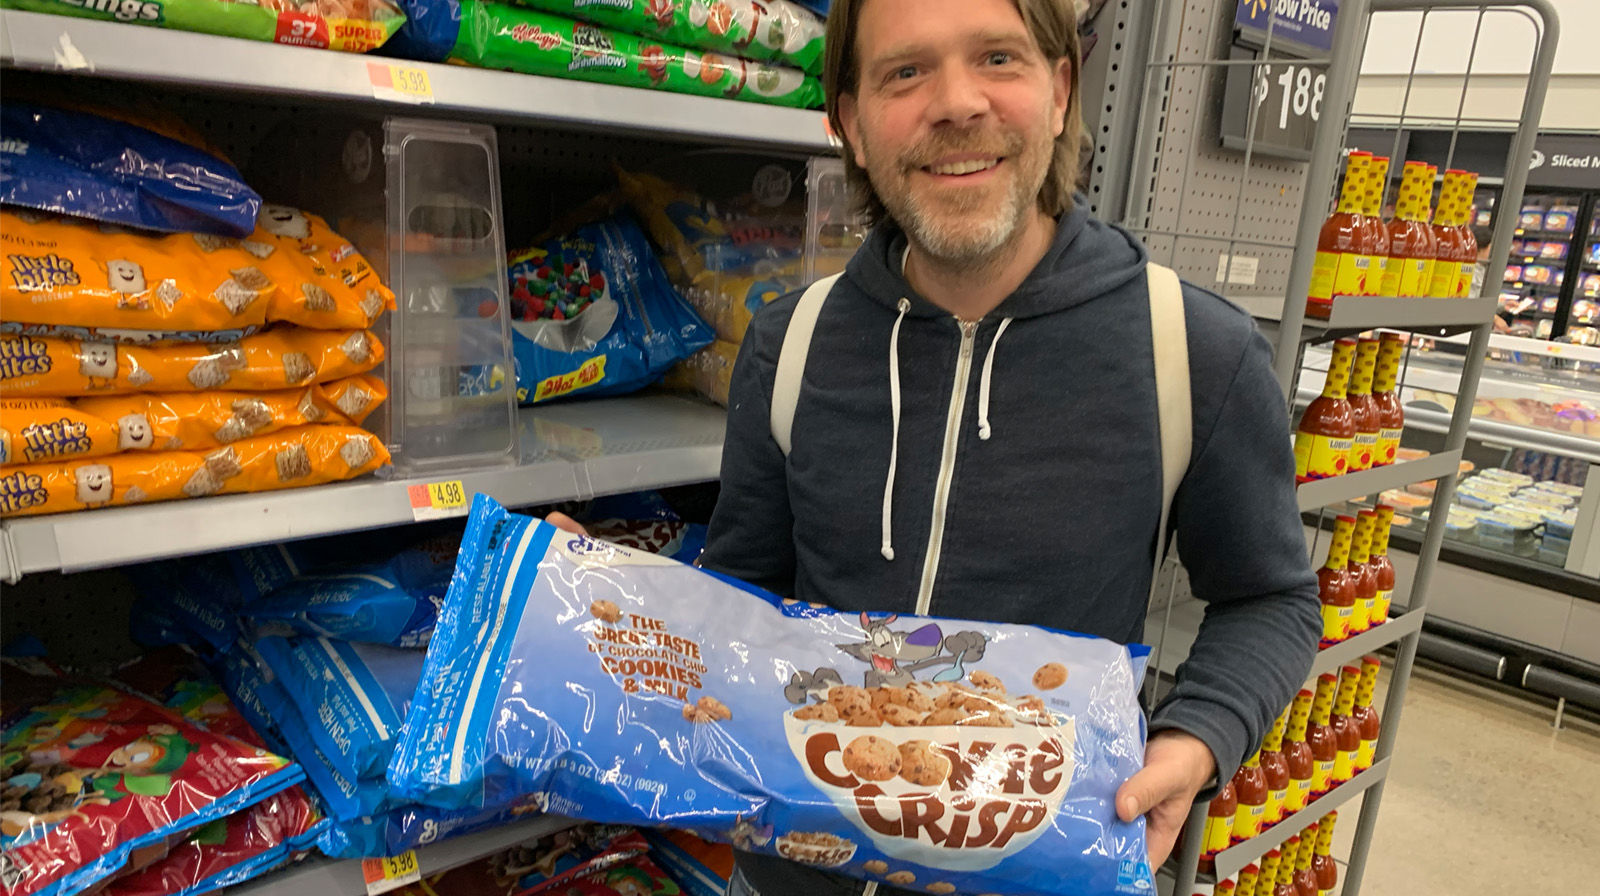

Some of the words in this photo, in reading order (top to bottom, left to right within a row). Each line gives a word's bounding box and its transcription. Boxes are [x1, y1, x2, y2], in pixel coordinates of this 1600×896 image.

[1270, 0, 1298, 19] ow
[1298, 0, 1331, 31] Price
[290, 19, 317, 38] 37
[335, 25, 382, 41] SUPER
[512, 22, 562, 52] Kellogg's
[1550, 153, 1590, 168] Sliced
[7, 253, 74, 273] little
[11, 268, 81, 294] bites
[0, 335, 48, 358] ttle
[21, 417, 88, 450] little
[24, 437, 92, 462] bites
[0, 471, 43, 496] ttle
[0, 488, 49, 512] ites
[471, 553, 495, 623] RESEALABLE
[629, 613, 667, 632] THE
[593, 625, 650, 647] GREAT
[652, 632, 701, 660] TASTE
[608, 645, 679, 663] CHOCOLATE
[682, 658, 708, 674] CHIP
[601, 656, 703, 689] COOKIES
[624, 677, 640, 693] &
[644, 678, 690, 702] MILK
[318, 702, 334, 730] HERE
[329, 723, 351, 757] OPEN
[577, 764, 594, 778] OZ
